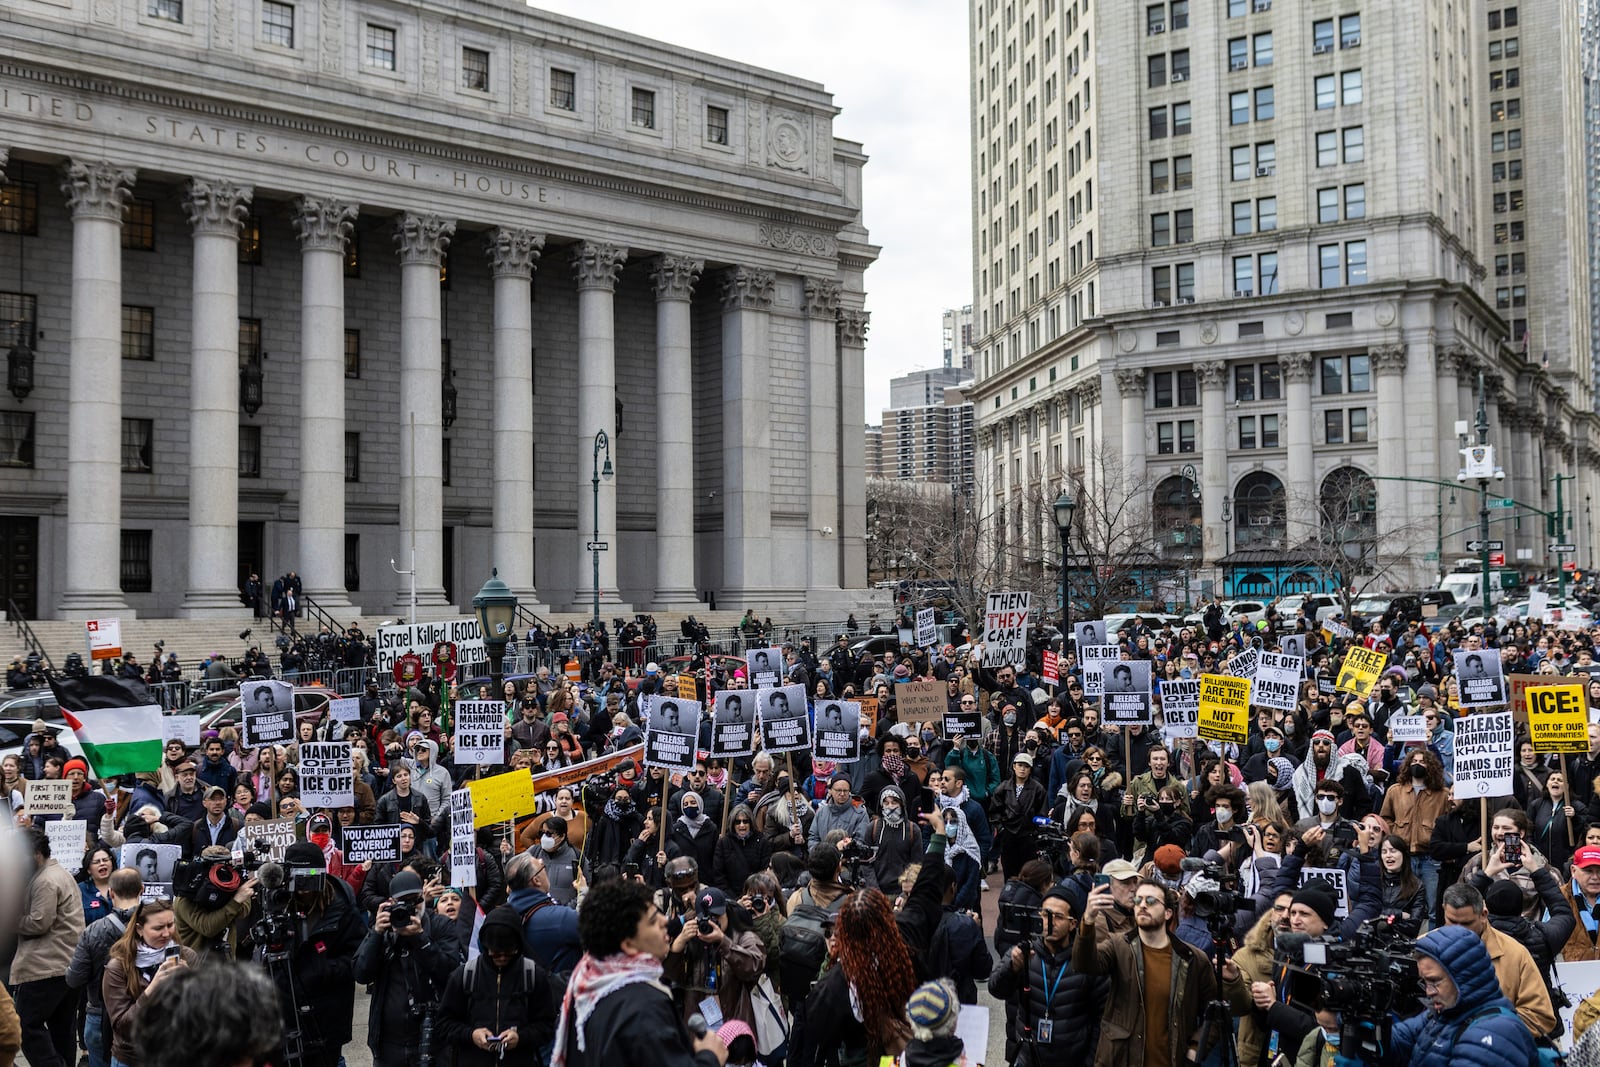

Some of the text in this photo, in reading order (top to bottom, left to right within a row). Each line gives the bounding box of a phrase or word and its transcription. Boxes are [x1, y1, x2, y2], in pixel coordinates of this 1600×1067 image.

[145, 116, 268, 153] STATES
[304, 145, 421, 180] COURT
[453, 171, 548, 203] HOUSE
[989, 592, 1028, 611] THEN
[987, 611, 1028, 630] THEY
[377, 621, 482, 649] Israel Killed 16,000
[987, 628, 1022, 642] CAME
[1000, 640, 1013, 648] FOR
[982, 647, 1025, 667] MAHMOUD
[1085, 647, 1118, 658] ICE OFF
[1349, 647, 1383, 668] FREE
[1228, 649, 1257, 673] HANDS
[1261, 653, 1300, 669] ICE OFF
[1344, 659, 1380, 676] PALESTINE
[905, 683, 933, 693] WWND
[1204, 677, 1248, 691] BILLIONAIRES
[1258, 680, 1296, 696] HANDS
[1467, 678, 1493, 687] RELEASE
[1205, 685, 1246, 700] ARE THE
[1464, 685, 1498, 694] MAHMOUD
[901, 695, 940, 705] WHAT WOULD
[1113, 694, 1141, 703] RELEASE
[1202, 694, 1246, 709] REAL ENEMY,
[1258, 691, 1294, 701] OFF
[459, 703, 503, 714] RELEASE
[1109, 702, 1145, 710] MAHMOUD
[1268, 698, 1294, 708] STUDENTS
[1530, 691, 1580, 714] ICE:
[903, 706, 930, 715] NAVALNY
[1115, 710, 1139, 718] KHALIL
[1166, 710, 1185, 723] ICE
[1212, 709, 1235, 723] NOT
[255, 713, 285, 725] RELEASE
[459, 714, 503, 723] MAHMOUD
[771, 719, 799, 730] RELEASE
[1396, 718, 1421, 726] FREE
[252, 721, 289, 733] MAHMOUD
[722, 724, 747, 734] RELEASE
[946, 721, 975, 729] MAHMOUD
[1200, 718, 1245, 732] IMMIGRANTS!
[1456, 714, 1511, 736] RELEASE
[1534, 722, 1584, 732] OUT OF OUR
[258, 731, 283, 741] KHALIL
[718, 732, 749, 743] MAHMOUD
[768, 726, 804, 739] MAHMOUD
[823, 731, 850, 741] RELEASE
[459, 734, 502, 747] ICE OFF
[656, 733, 687, 746] RELEASE
[775, 735, 798, 746] KHALIL
[819, 739, 853, 748] MAHMOUD
[1455, 730, 1511, 748] MAHMOUD
[301, 744, 350, 760] HANDS
[651, 741, 690, 755] MAHMOUD
[825, 747, 847, 756] KHALIL
[1456, 743, 1512, 756] KHALIL
[657, 750, 682, 762] KHALIL
[302, 759, 350, 768] OFF
[1456, 756, 1512, 773] HANDS OFF
[301, 766, 351, 775] OUR STUDENTS
[1456, 768, 1511, 782] OUR STUDENTS
[30, 784, 70, 792] FIRST THEY
[302, 776, 352, 791] ICE OFF
[53, 793, 66, 801] FOR
[48, 823, 86, 833] OPPOSING
[247, 821, 294, 837] RELEASE
[343, 827, 400, 841] YOU CANNOT
[351, 839, 393, 851] COVERUP
[348, 849, 397, 862] GENOCIDE
